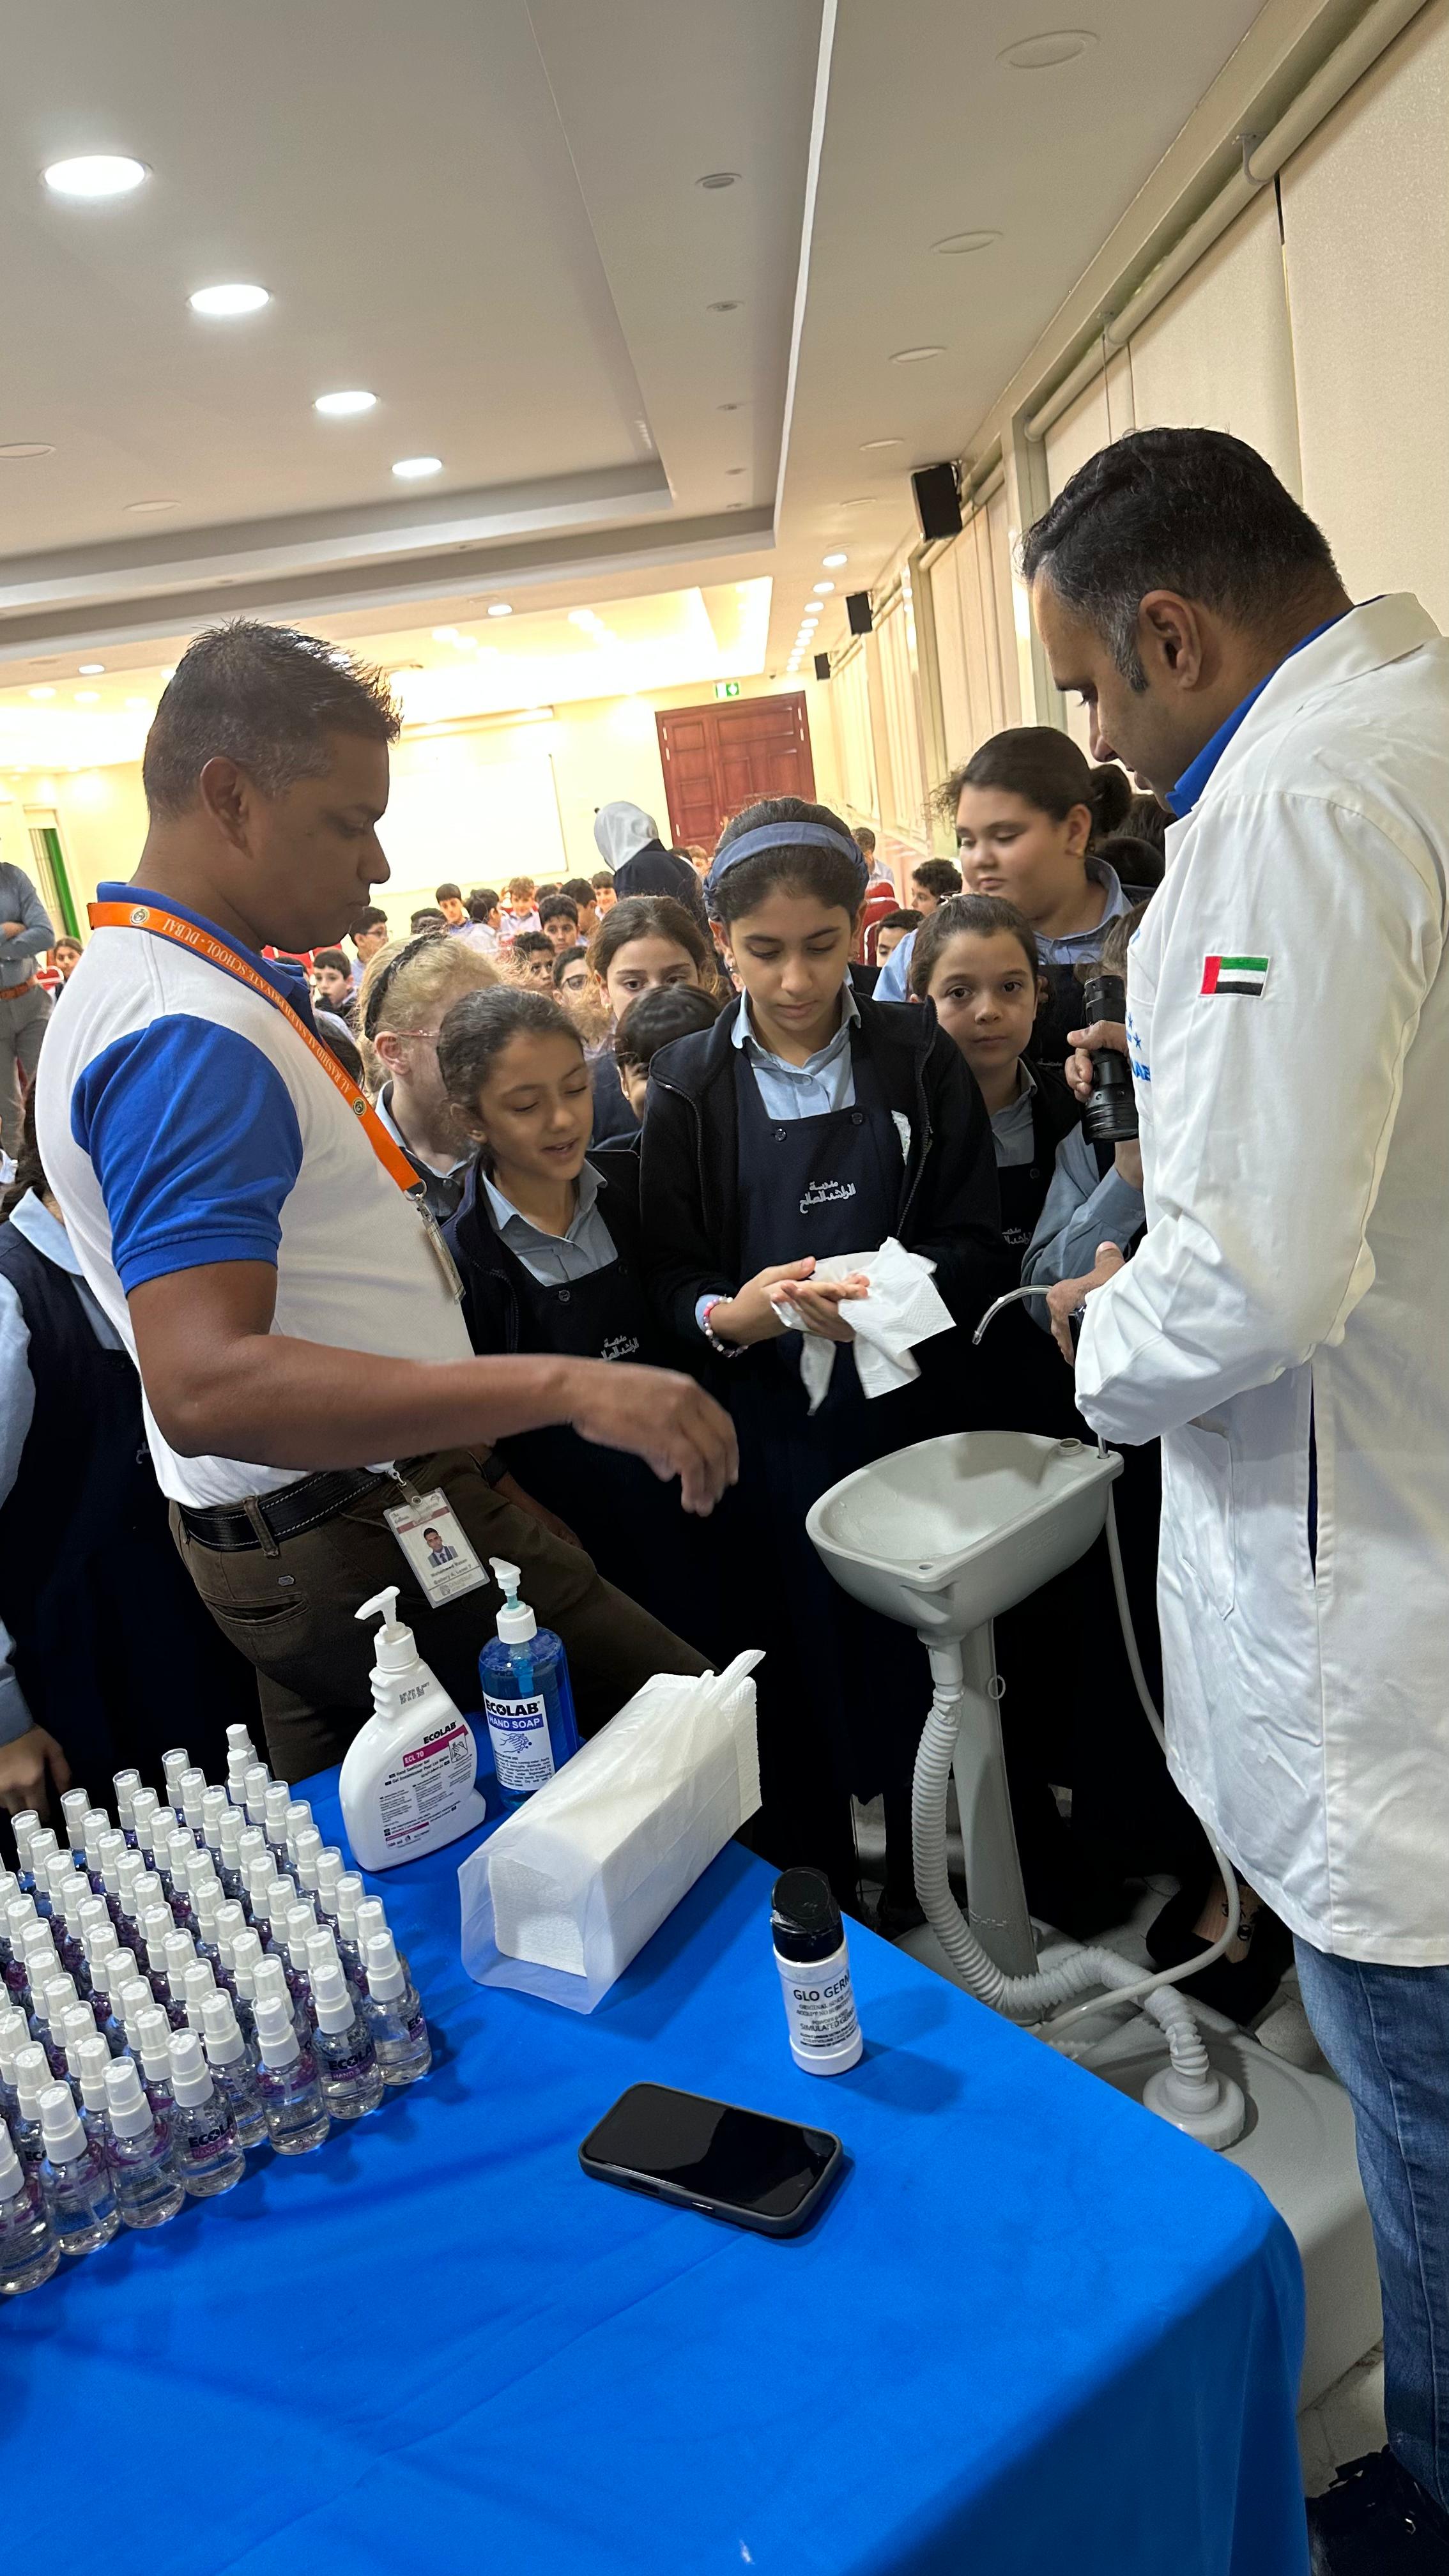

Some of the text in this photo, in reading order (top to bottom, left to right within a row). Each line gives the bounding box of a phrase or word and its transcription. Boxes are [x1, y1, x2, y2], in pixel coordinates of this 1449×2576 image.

[162, 918, 201, 945] DUBAI
[206, 940, 248, 975] SCHOOL
[249, 971, 286, 1008] PRIVATE
[308, 1038, 317, 1048] AL
[316, 1048, 342, 1082] RASHID
[340, 1077, 351, 1093] AL
[809, 1181, 839, 1191] مدرسة
[604, 1335, 627, 1347] مدرسة
[486, 1699, 539, 1717] ECOLAB
[489, 1716, 540, 1729] HAND SOAP
[424, 1722, 456, 1744] ECOLAB
[404, 1756, 415, 1764] ECL
[793, 1989, 820, 2002] GLO
[800, 2020, 839, 2031] SIMULATED
[328, 2043, 373, 2071] ECOLA
